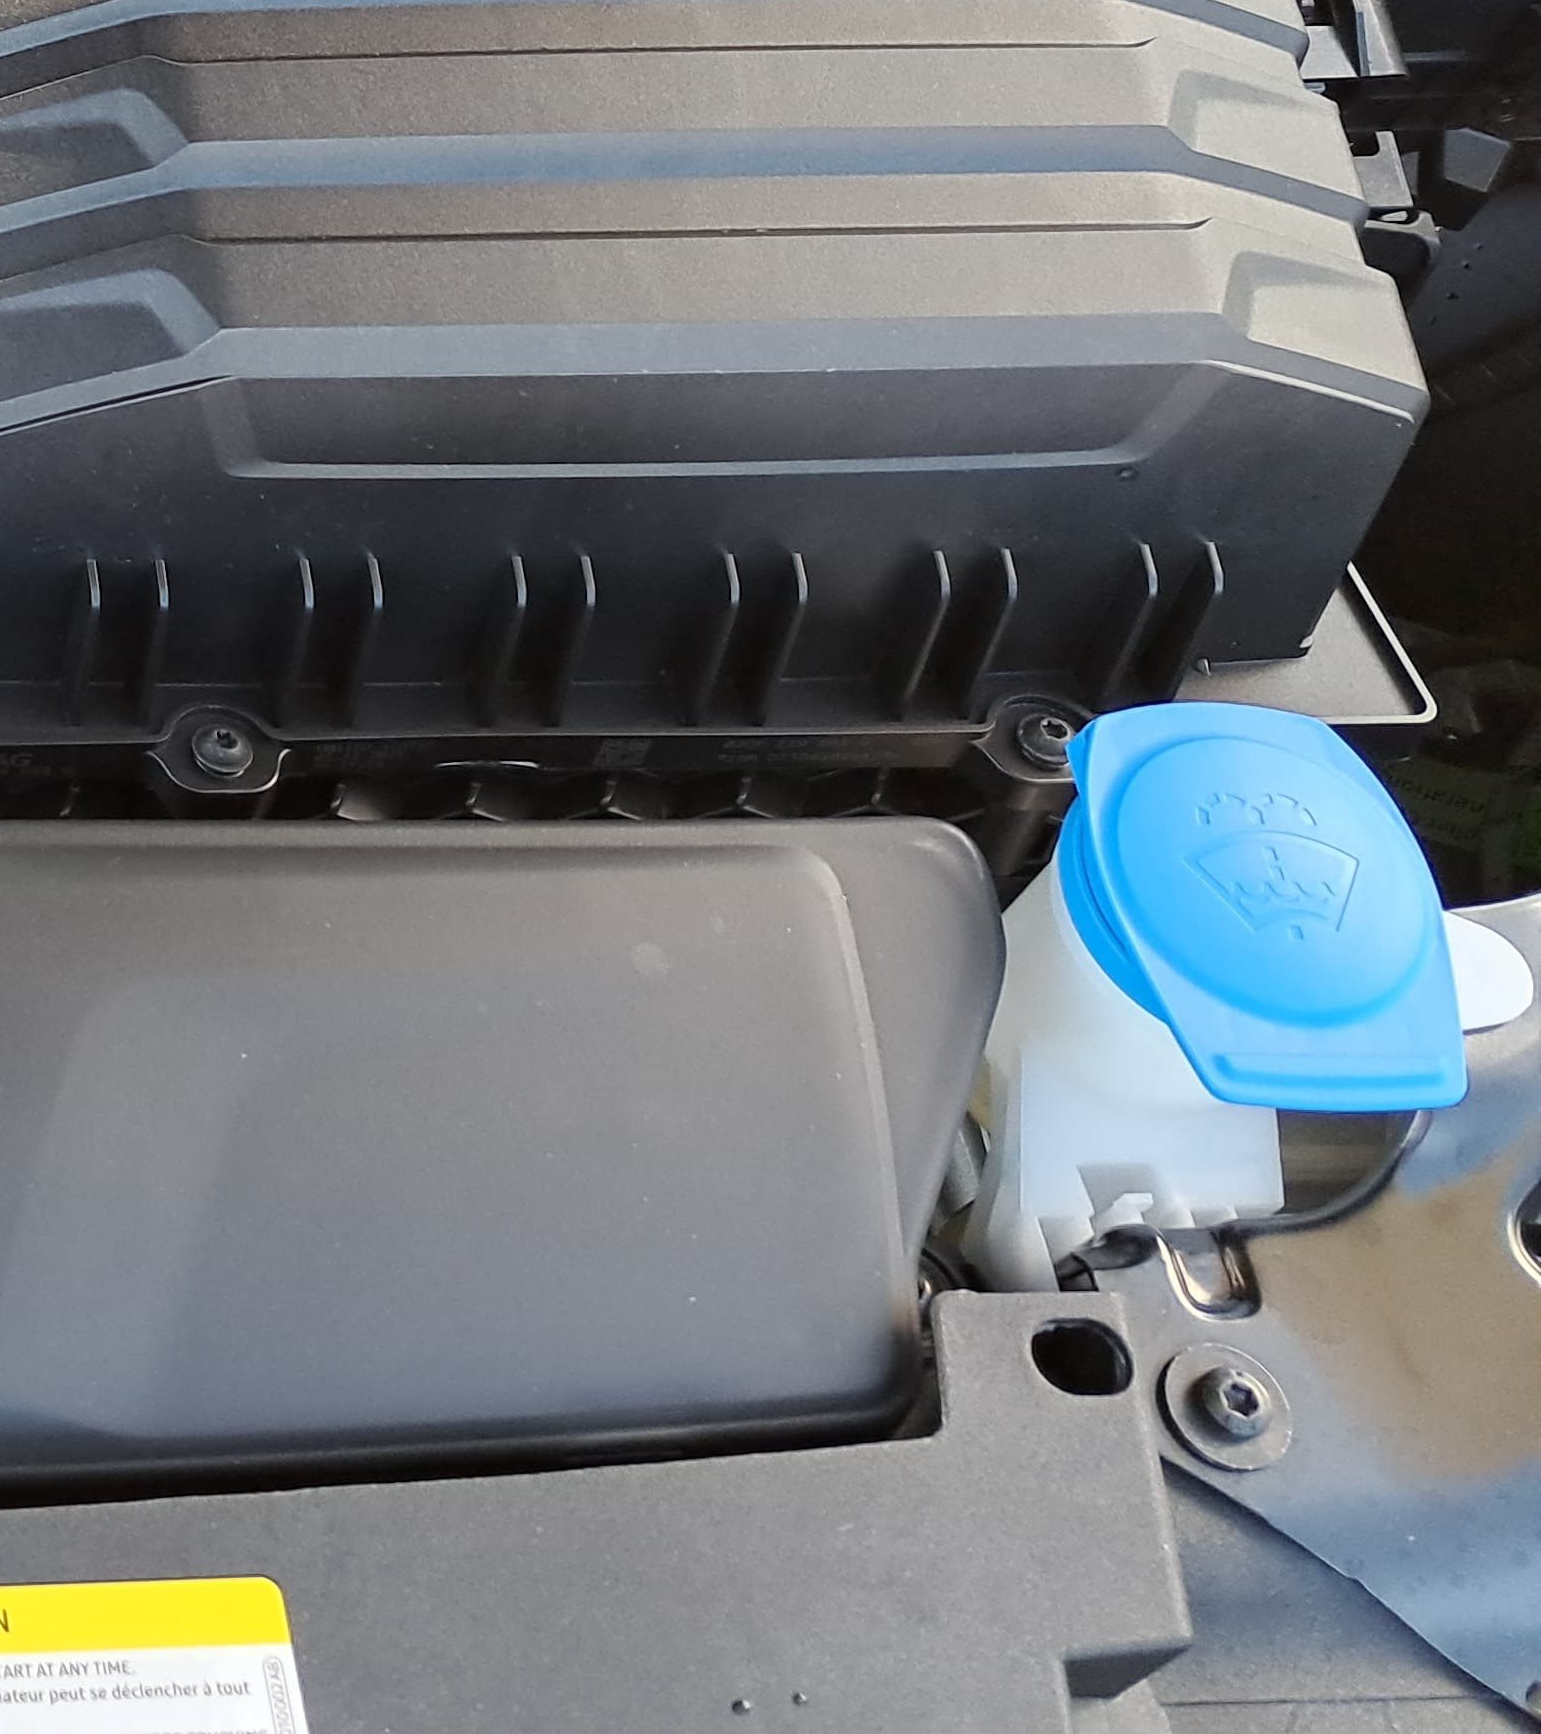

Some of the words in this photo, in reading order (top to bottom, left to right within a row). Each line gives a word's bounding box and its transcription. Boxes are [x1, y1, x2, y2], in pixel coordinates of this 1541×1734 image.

[36, 1662, 54, 1678] AT
[58, 1660, 89, 1676] ANY
[95, 1660, 136, 1676] TIME.
[49, 1686, 84, 1704] peut
[90, 1688, 108, 1700] se
[112, 1682, 198, 1700] déclencher
[203, 1681, 212, 1696] à
[217, 1681, 251, 1696] tout
